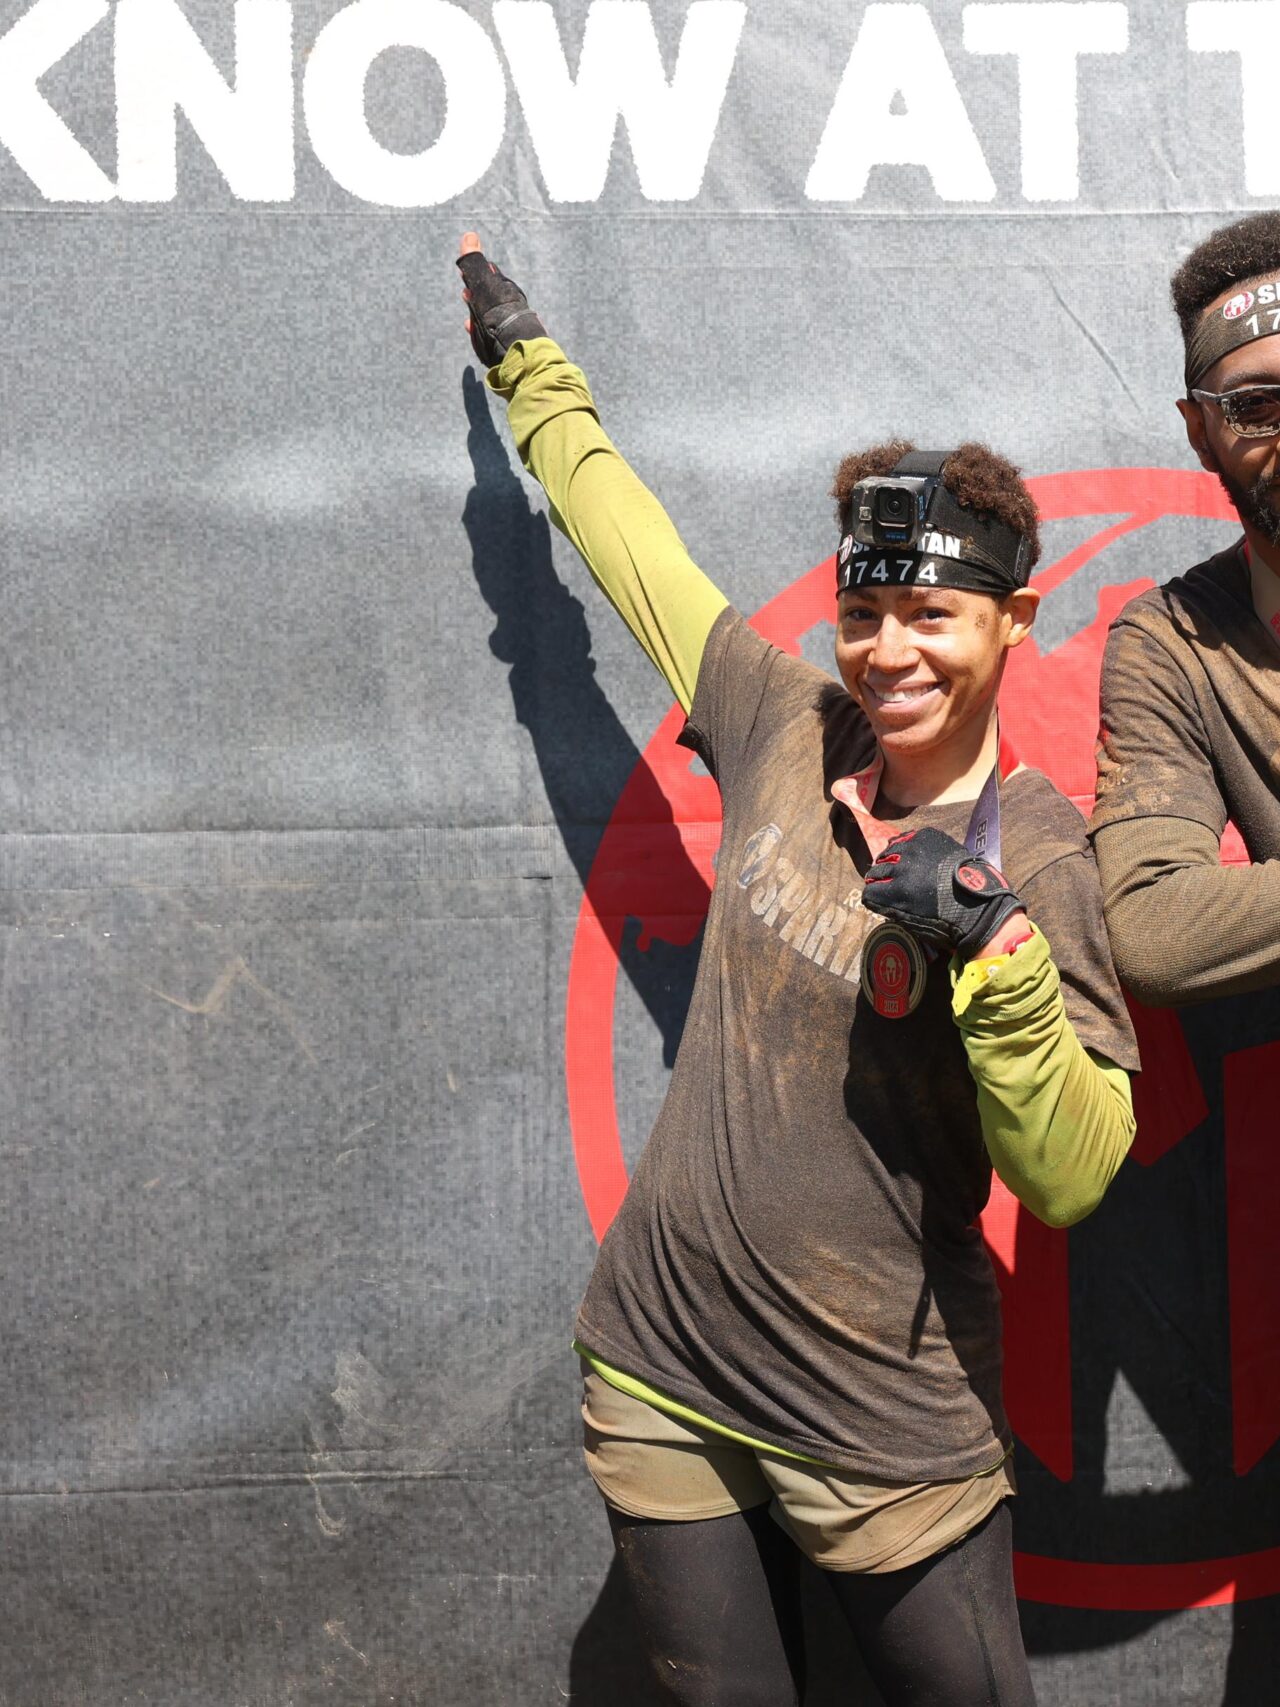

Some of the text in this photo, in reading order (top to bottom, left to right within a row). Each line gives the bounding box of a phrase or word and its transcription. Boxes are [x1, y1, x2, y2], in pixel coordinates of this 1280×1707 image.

[804, 1, 1129, 201] AT
[844, 558, 938, 587] 17474
[750, 857, 866, 985] SPART
